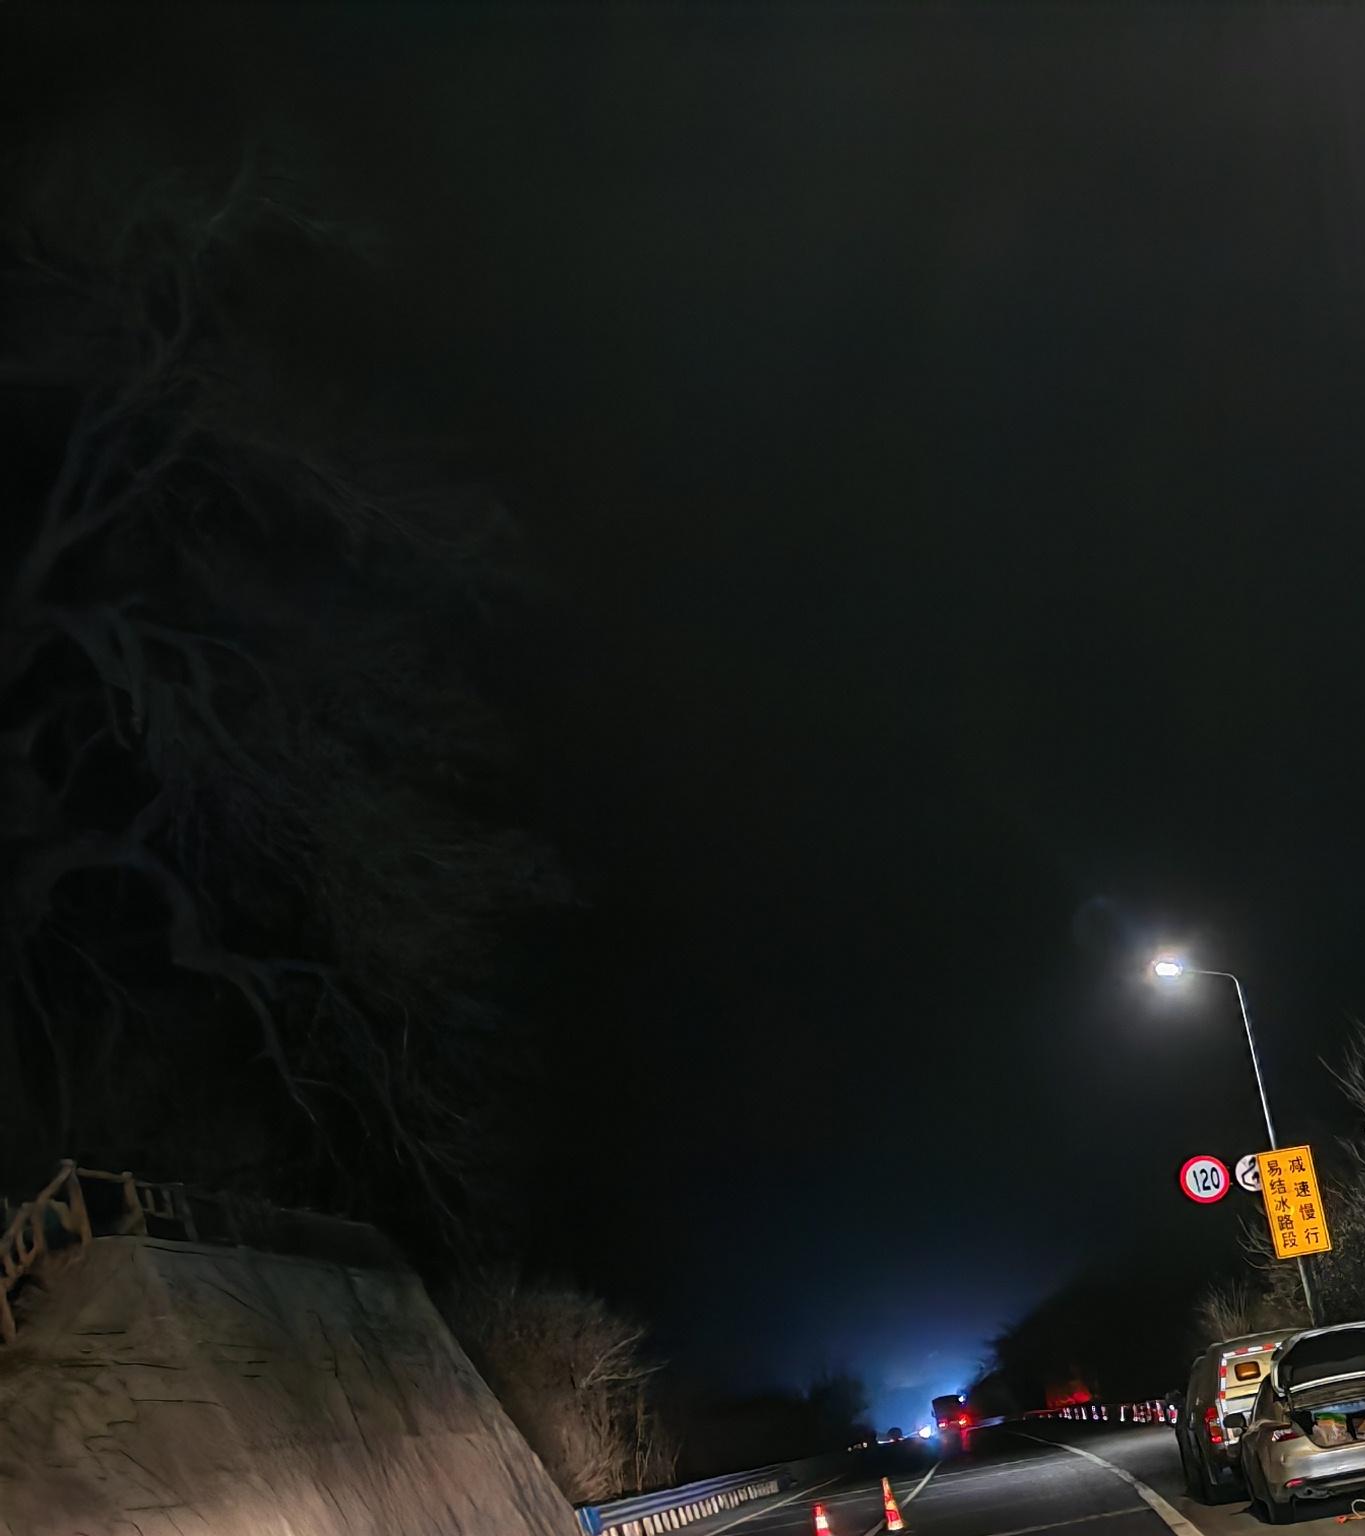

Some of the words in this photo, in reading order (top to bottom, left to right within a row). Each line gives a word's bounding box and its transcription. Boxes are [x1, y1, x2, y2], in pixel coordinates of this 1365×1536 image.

[1193, 1166, 1220, 1193] 120
[1267, 1159, 1298, 1249] 易结冰路段
[1288, 1155, 1320, 1245] 减速慢行
